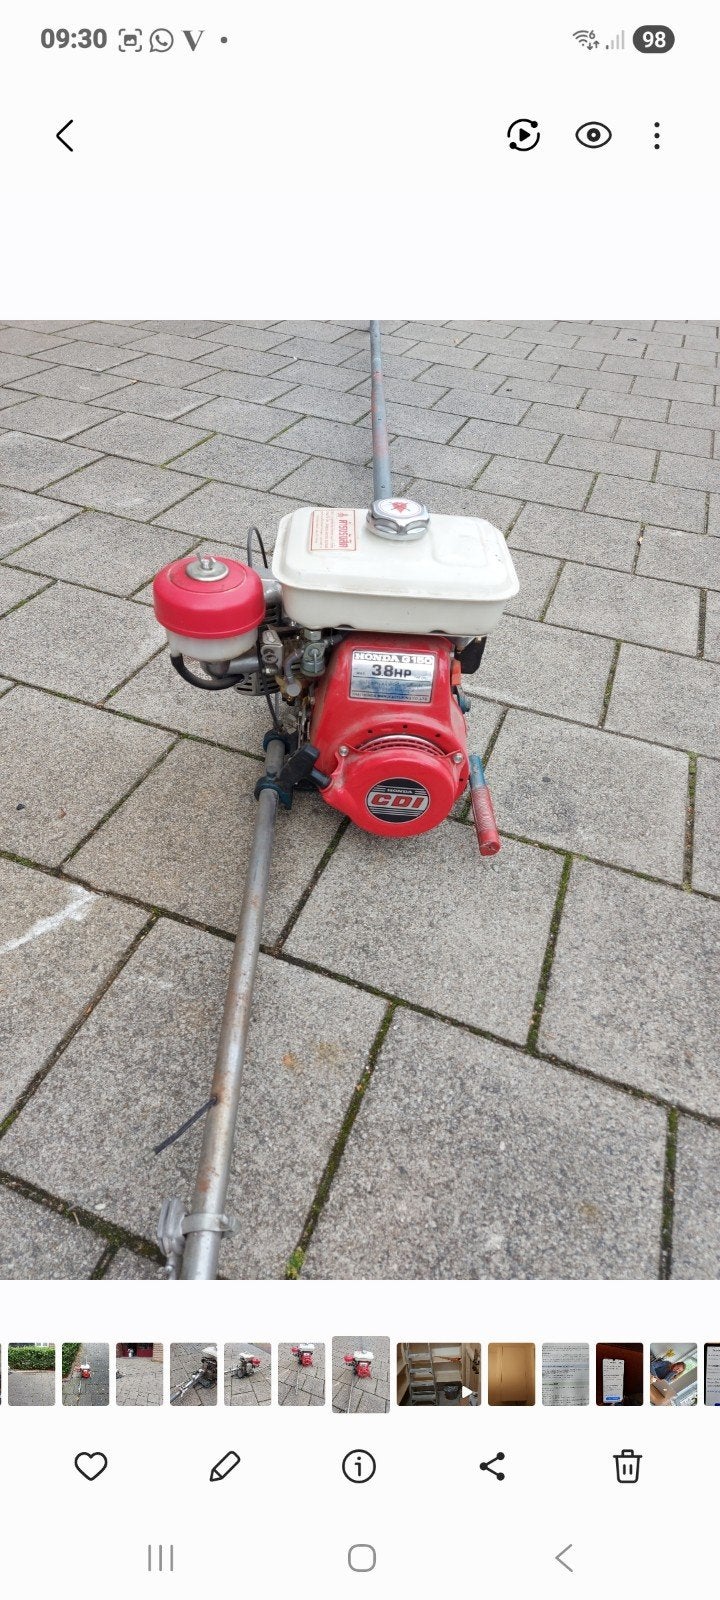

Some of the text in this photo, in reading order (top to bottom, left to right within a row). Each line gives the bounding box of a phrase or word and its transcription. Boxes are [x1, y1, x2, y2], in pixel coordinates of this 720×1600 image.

[41, 28, 107, 49] 09:30
[642, 31, 666, 48] 98
[354, 652, 400, 662] HONDA
[371, 793, 425, 809] CDI
